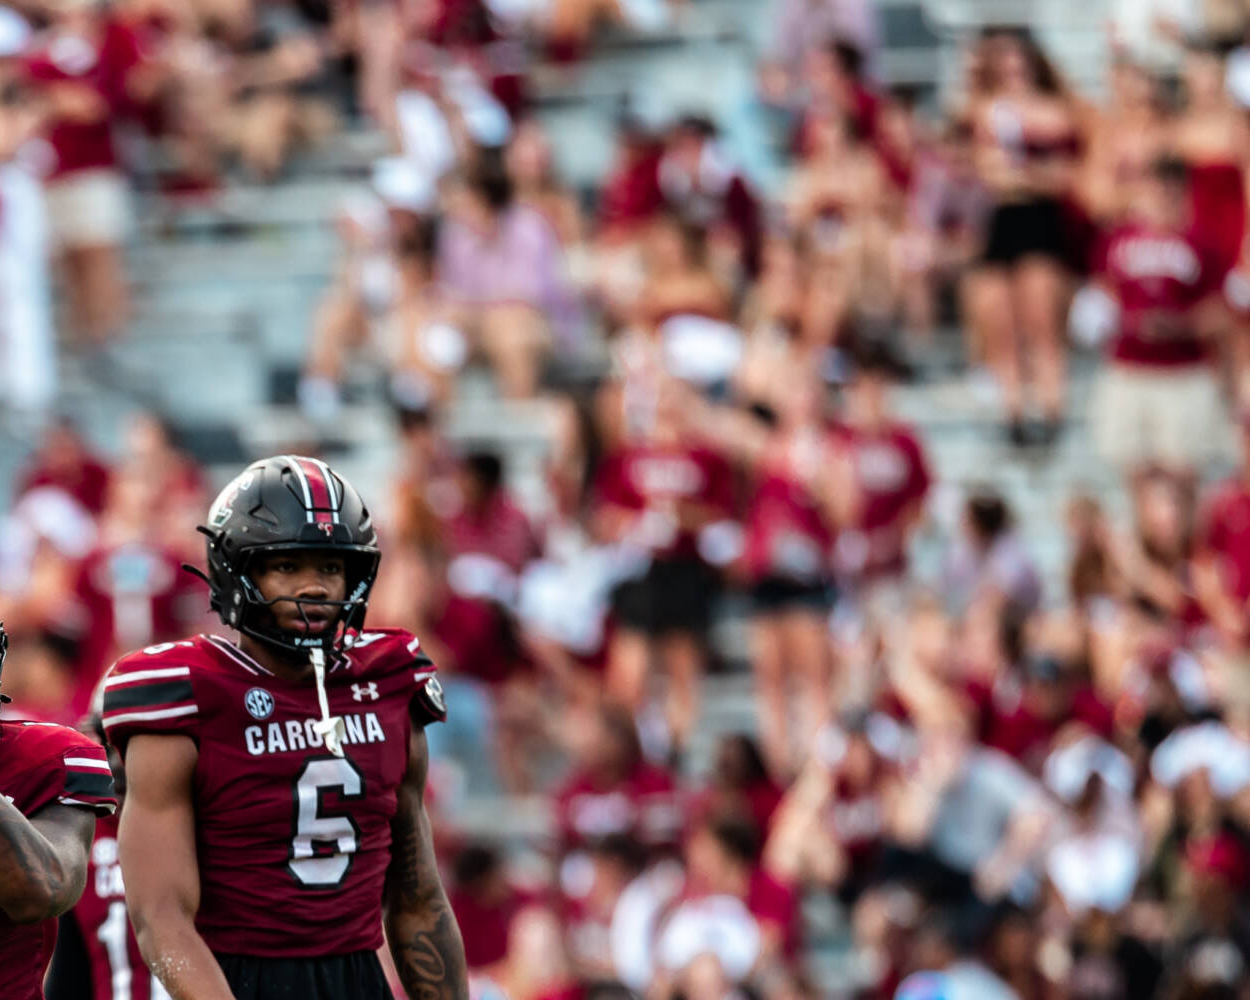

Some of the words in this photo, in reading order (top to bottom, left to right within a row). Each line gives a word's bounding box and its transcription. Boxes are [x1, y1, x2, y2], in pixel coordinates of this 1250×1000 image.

[247, 689, 273, 717] SEC
[245, 713, 386, 756] CARONA
[288, 758, 361, 885] 6
